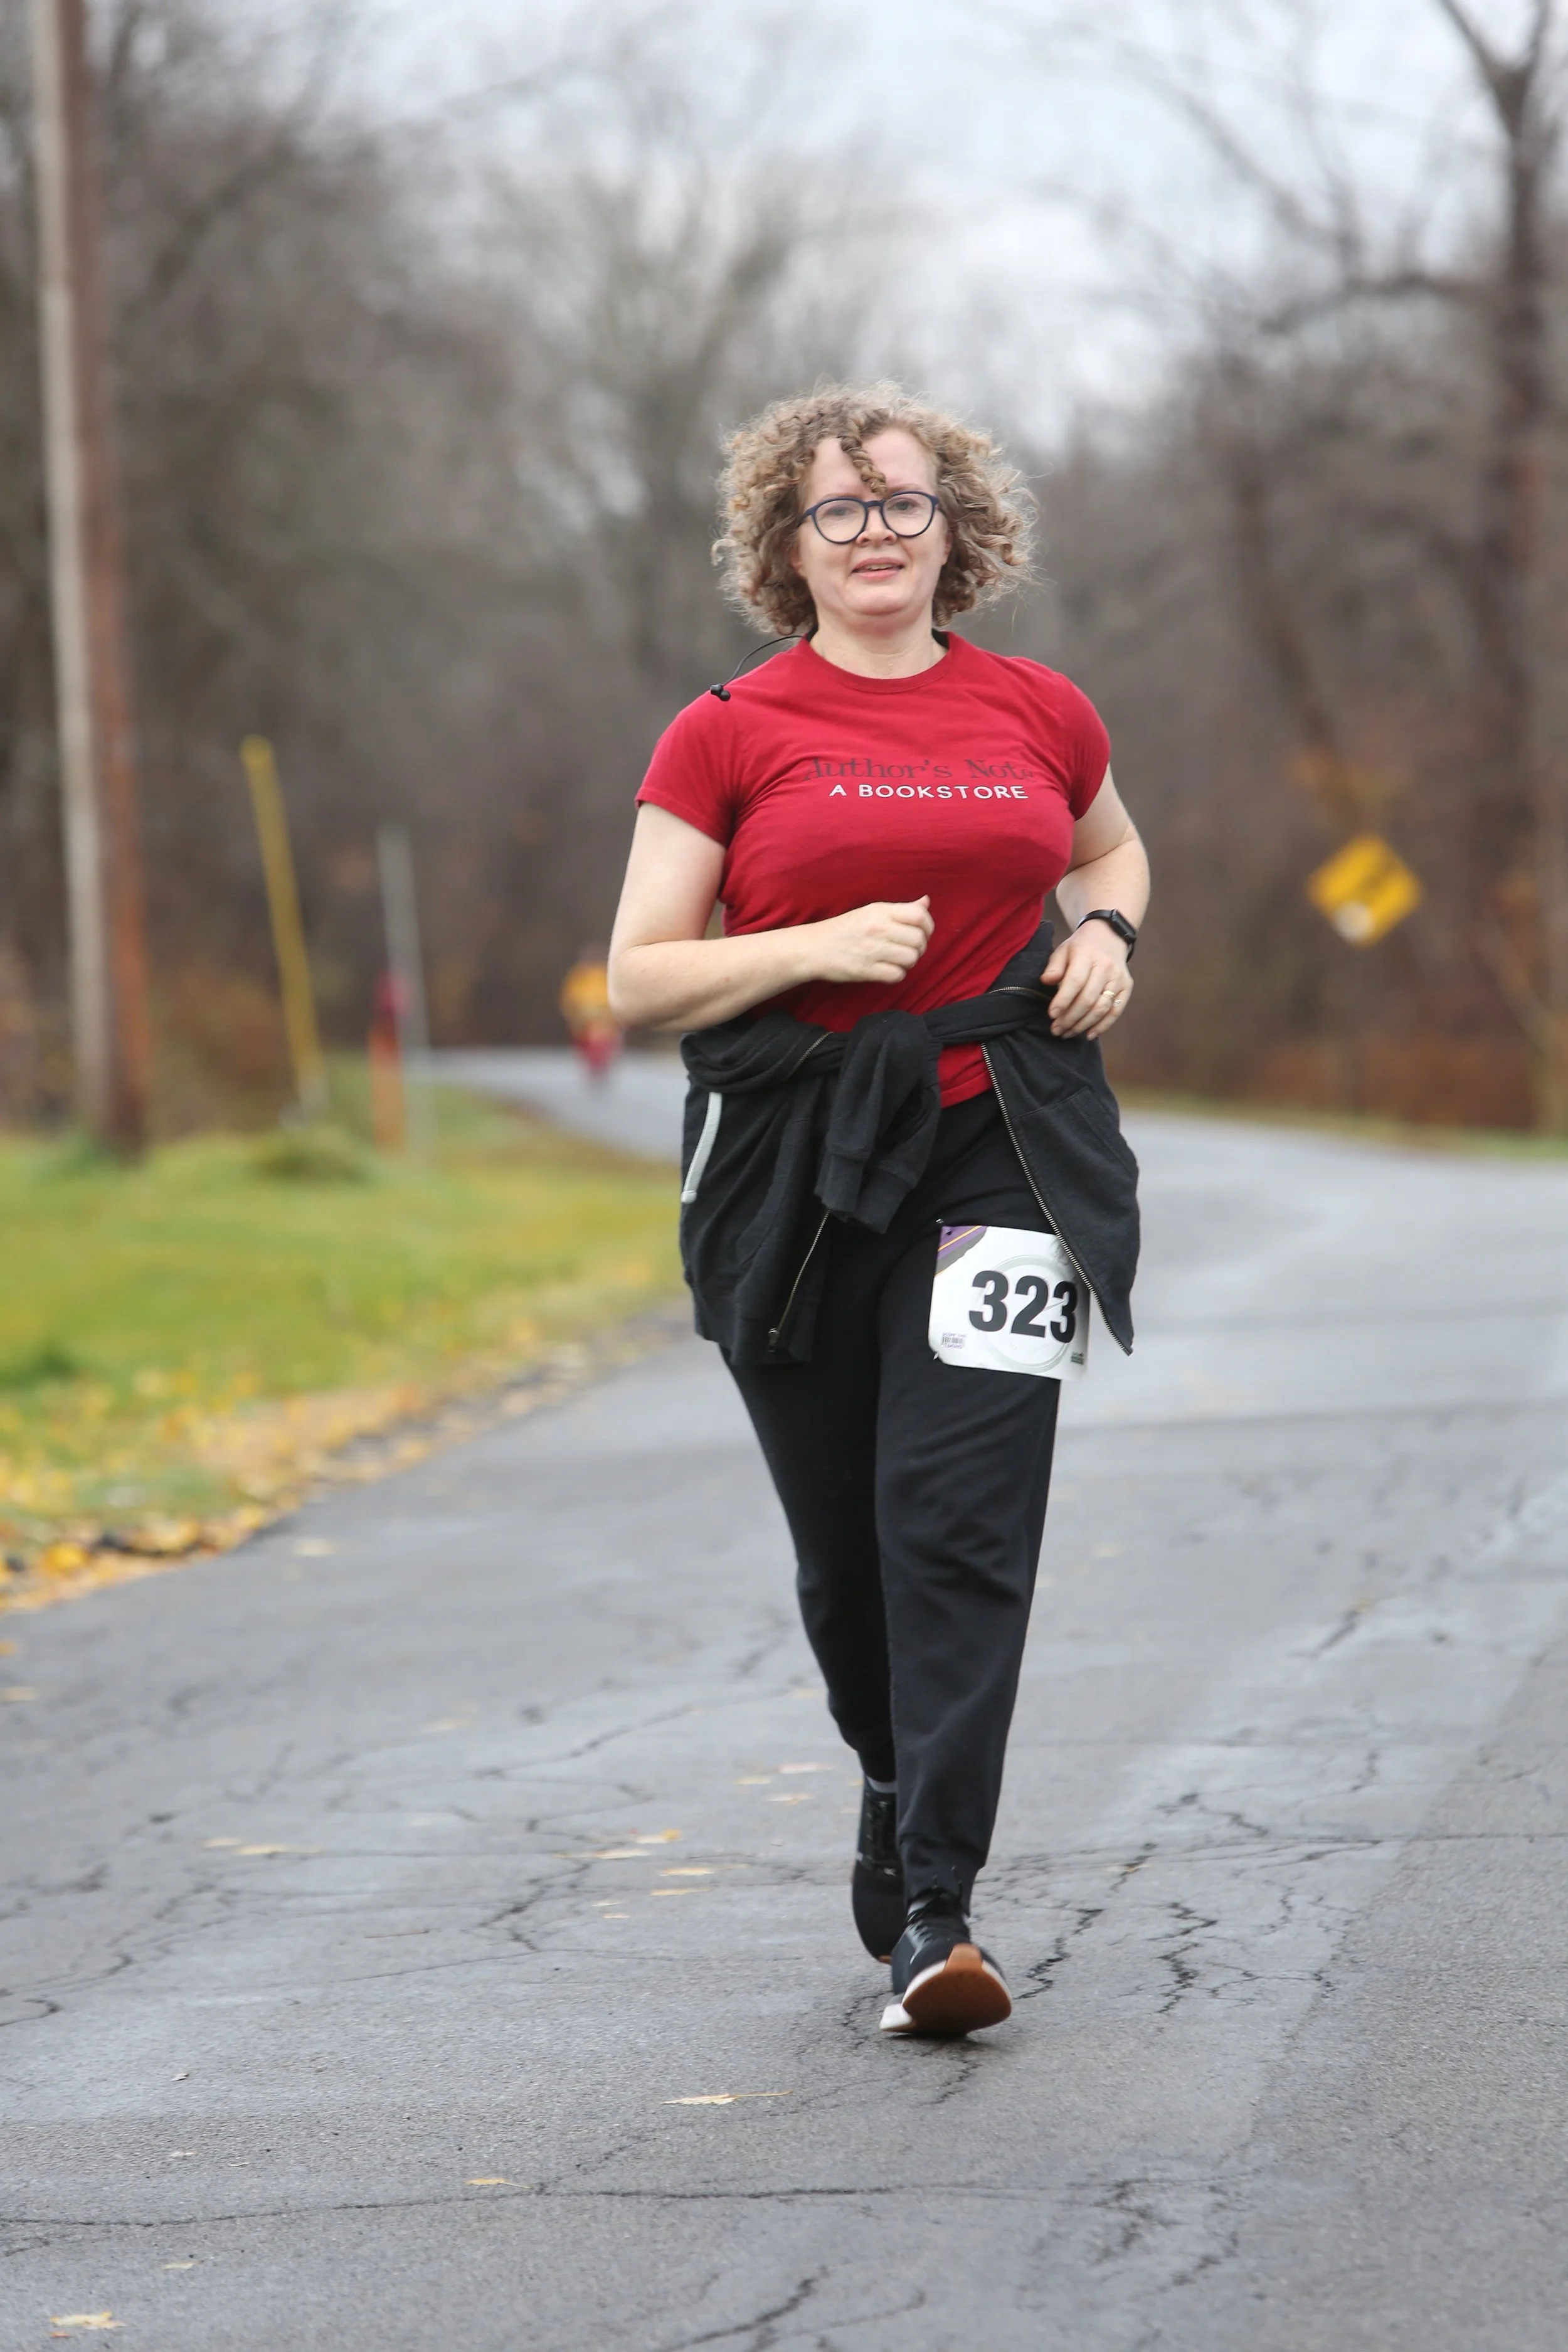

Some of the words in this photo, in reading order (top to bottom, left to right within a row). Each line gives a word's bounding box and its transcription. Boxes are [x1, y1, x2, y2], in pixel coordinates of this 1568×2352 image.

[803, 756, 952, 781] Author's
[829, 783, 847, 797] A
[858, 783, 1029, 800] BOOKSTORE
[969, 1269, 1078, 1343] 323
